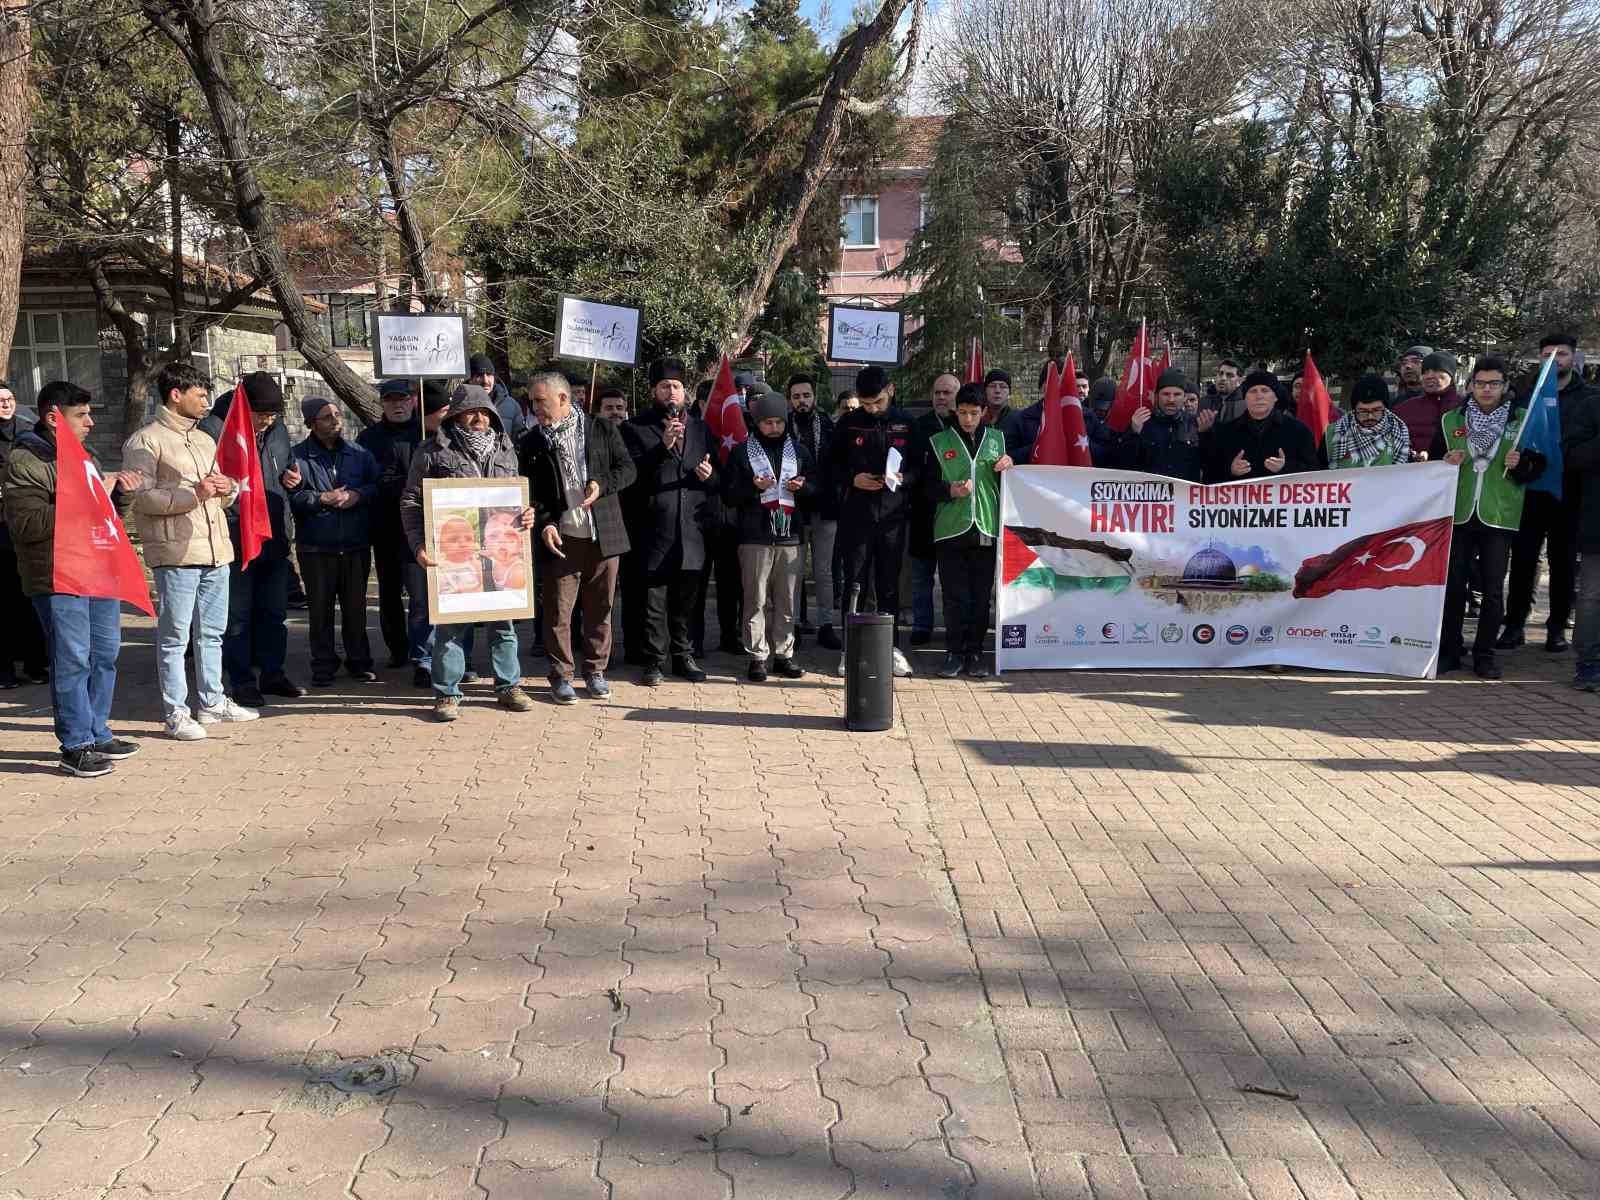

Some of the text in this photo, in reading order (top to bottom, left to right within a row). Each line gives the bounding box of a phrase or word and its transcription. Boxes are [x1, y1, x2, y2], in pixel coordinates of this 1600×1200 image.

[1280, 483, 1352, 505] DESTEK
[1091, 503, 1174, 533] HAYIR!
[1188, 505, 1351, 528] SİYONİZME LANET
